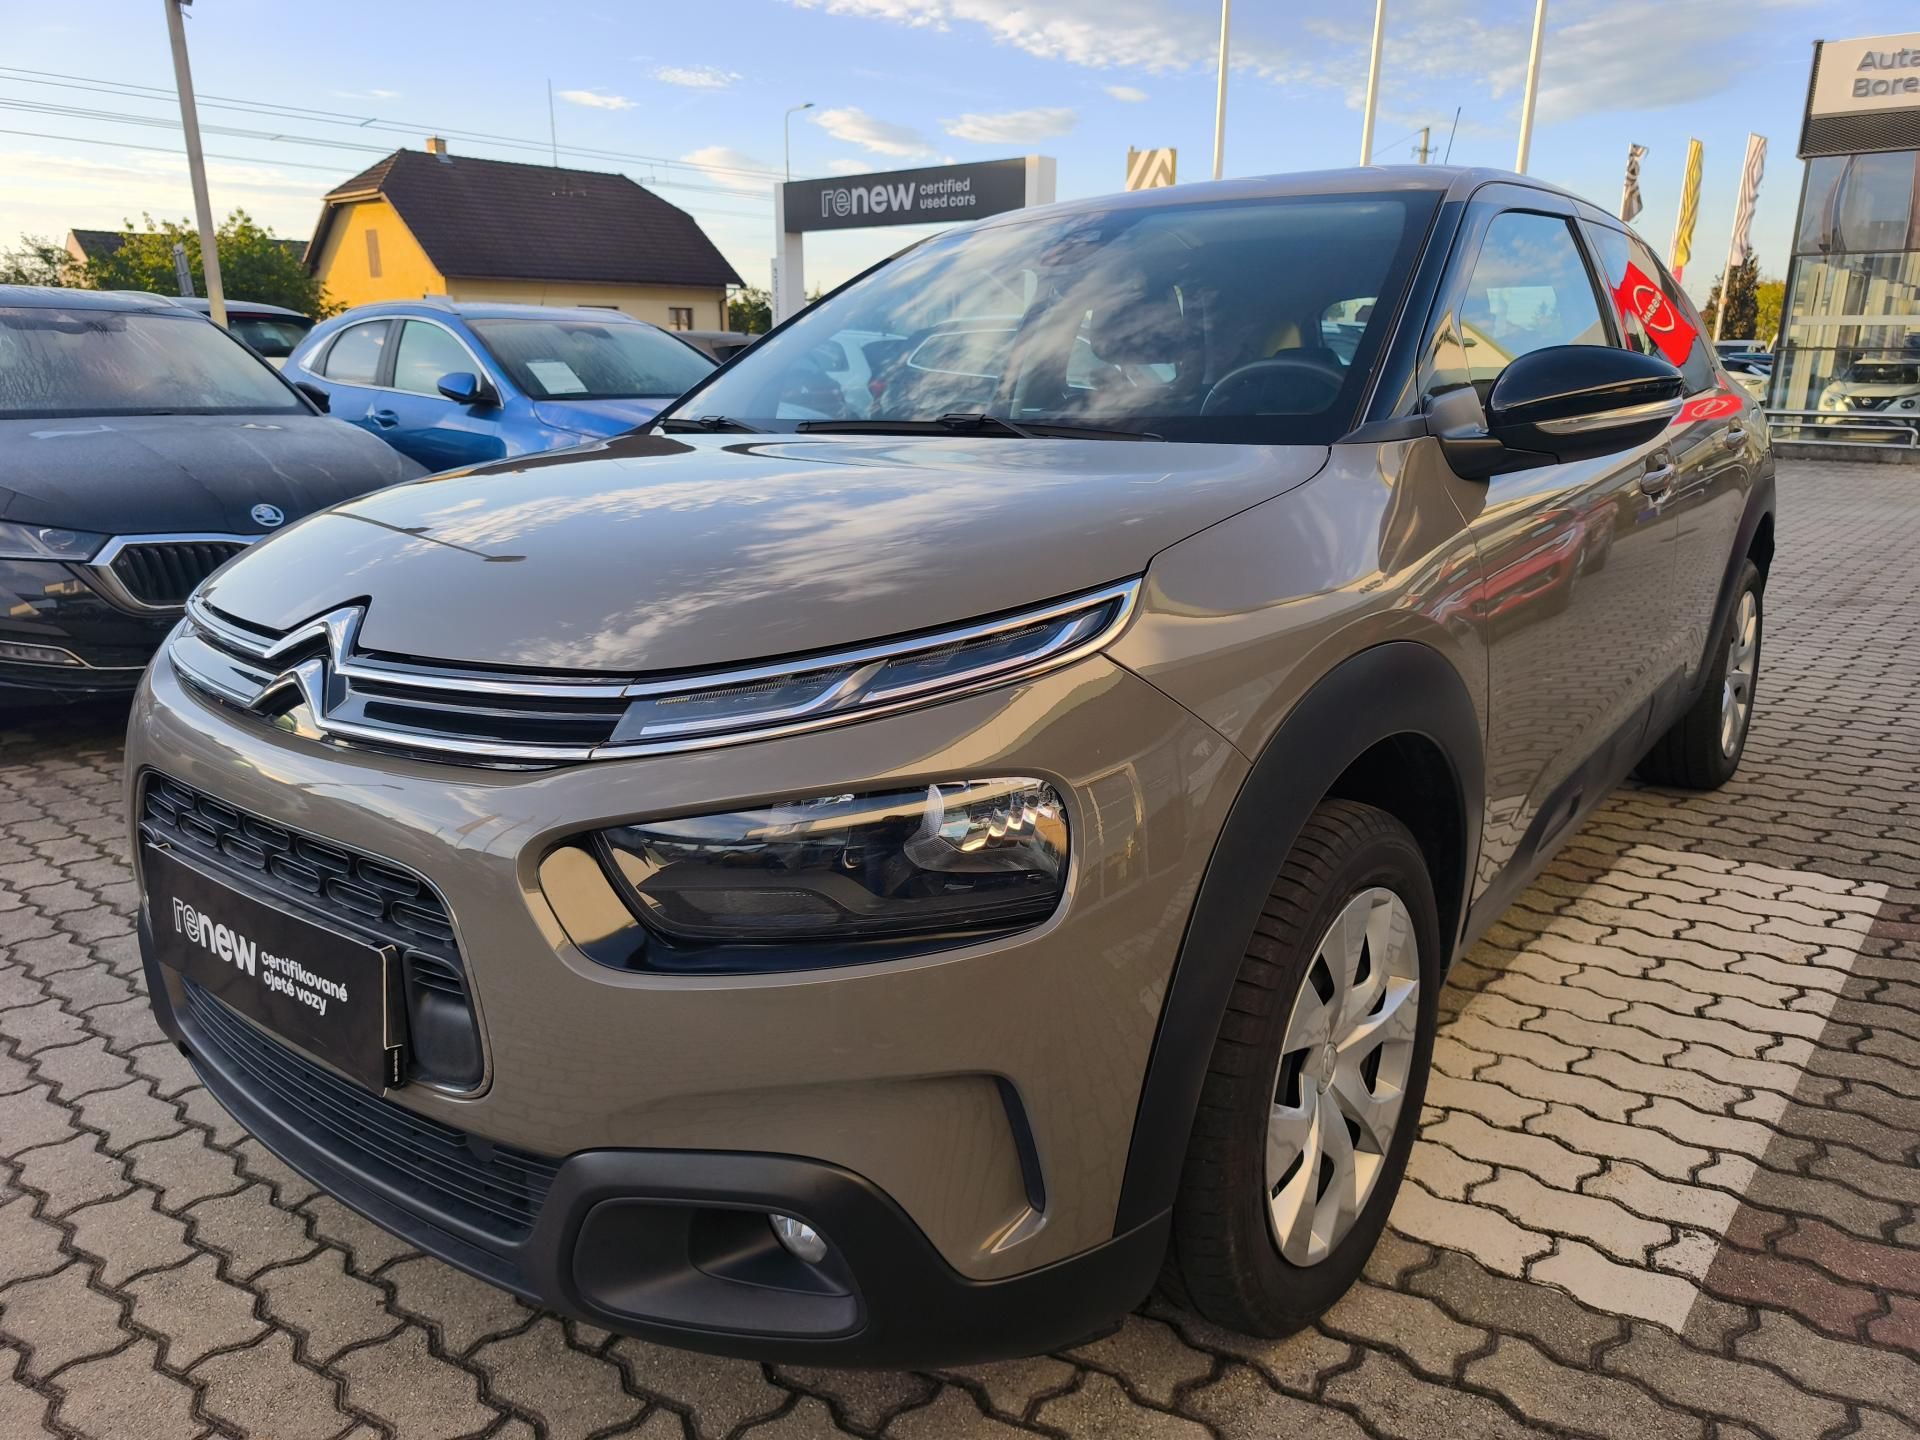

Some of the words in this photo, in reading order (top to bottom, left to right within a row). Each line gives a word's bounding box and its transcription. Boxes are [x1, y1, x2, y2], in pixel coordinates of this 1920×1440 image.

[821, 182, 916, 217] renew
[919, 178, 970, 195] certified
[919, 192, 948, 209] used
[949, 193, 976, 207] cars
[172, 896, 256, 977] renew
[261, 951, 348, 1003] certifikované
[263, 970, 295, 997] ojeté
[297, 988, 327, 1016] vozy
